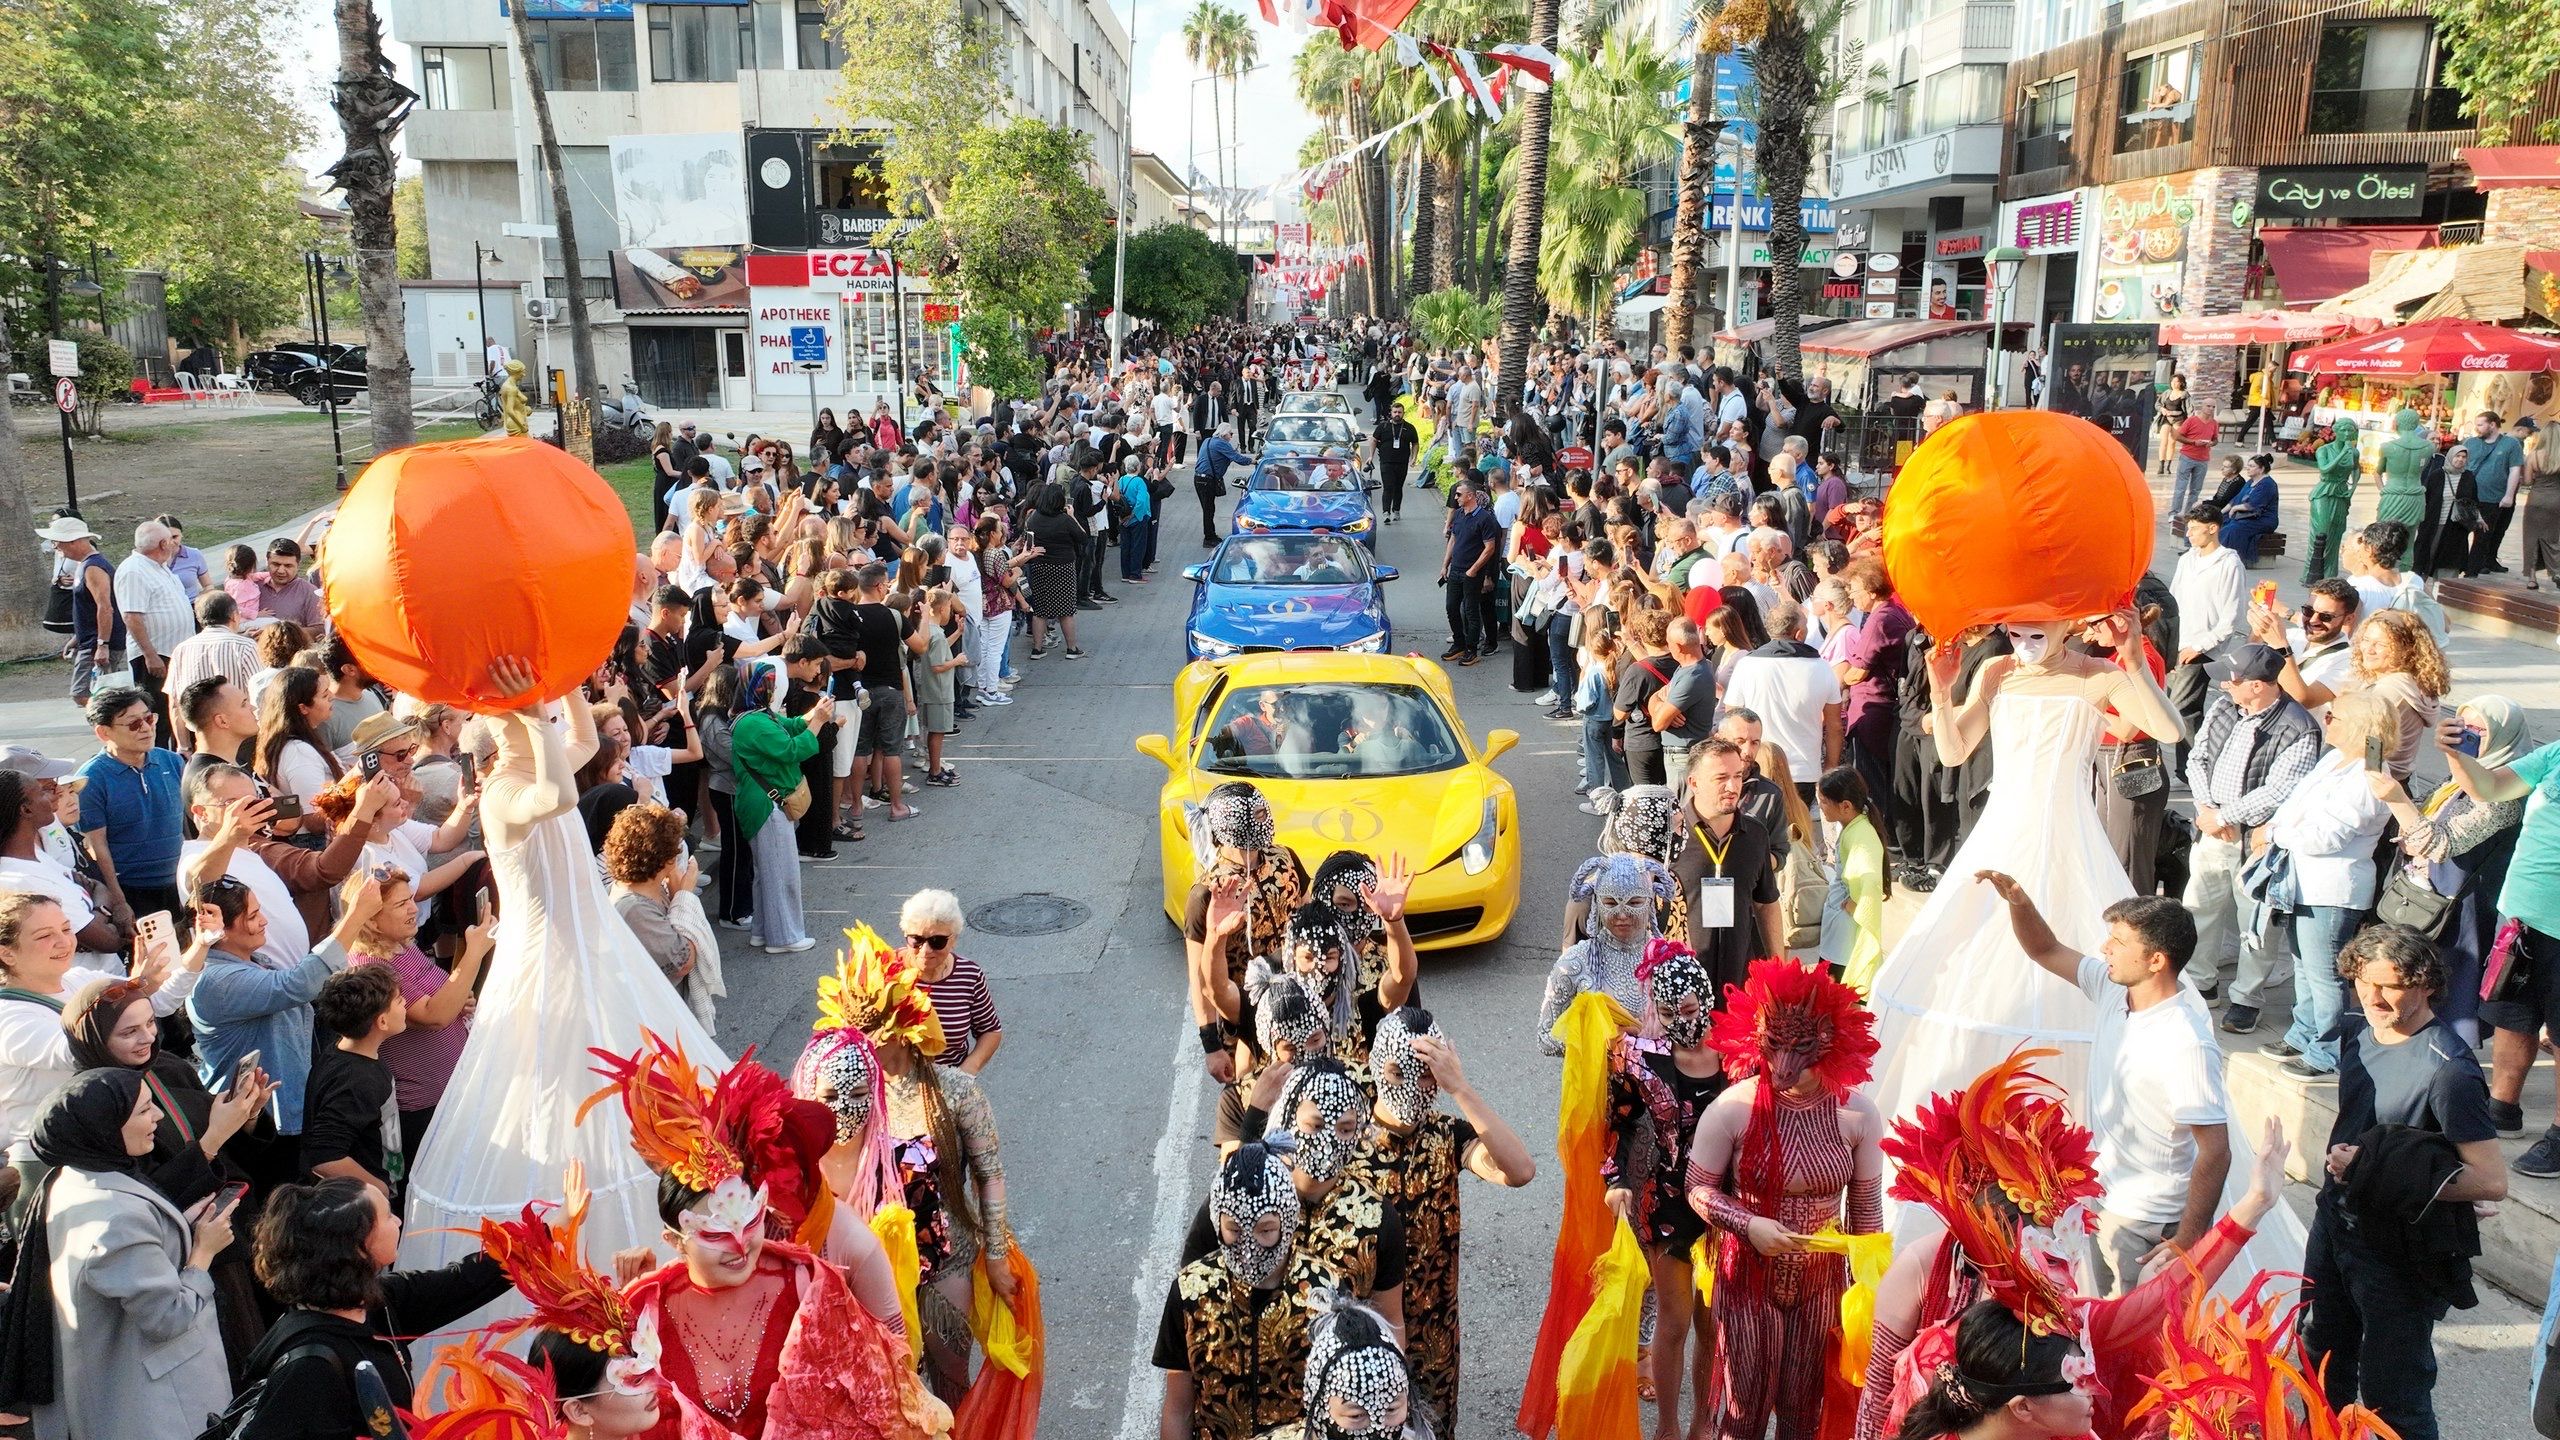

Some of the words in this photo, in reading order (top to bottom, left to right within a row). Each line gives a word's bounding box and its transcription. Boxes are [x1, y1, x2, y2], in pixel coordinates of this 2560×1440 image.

[2268, 178, 2324, 210] Çay
[2330, 188, 2351, 200] ve
[2357, 173, 2416, 200] Ötesi
[1713, 206, 1766, 226] RENK
[842, 218, 923, 233] BARBEROWN
[1754, 249, 1830, 264] PHACY
[1823, 284, 1861, 298] HOTEL
[760, 308, 831, 321] APOTHEKE
[760, 335, 832, 347] PHAY
[2336, 358, 2369, 369] Gerçek
[2370, 358, 2403, 368] Mucize
[2461, 353, 2512, 369] Coca-Cola
